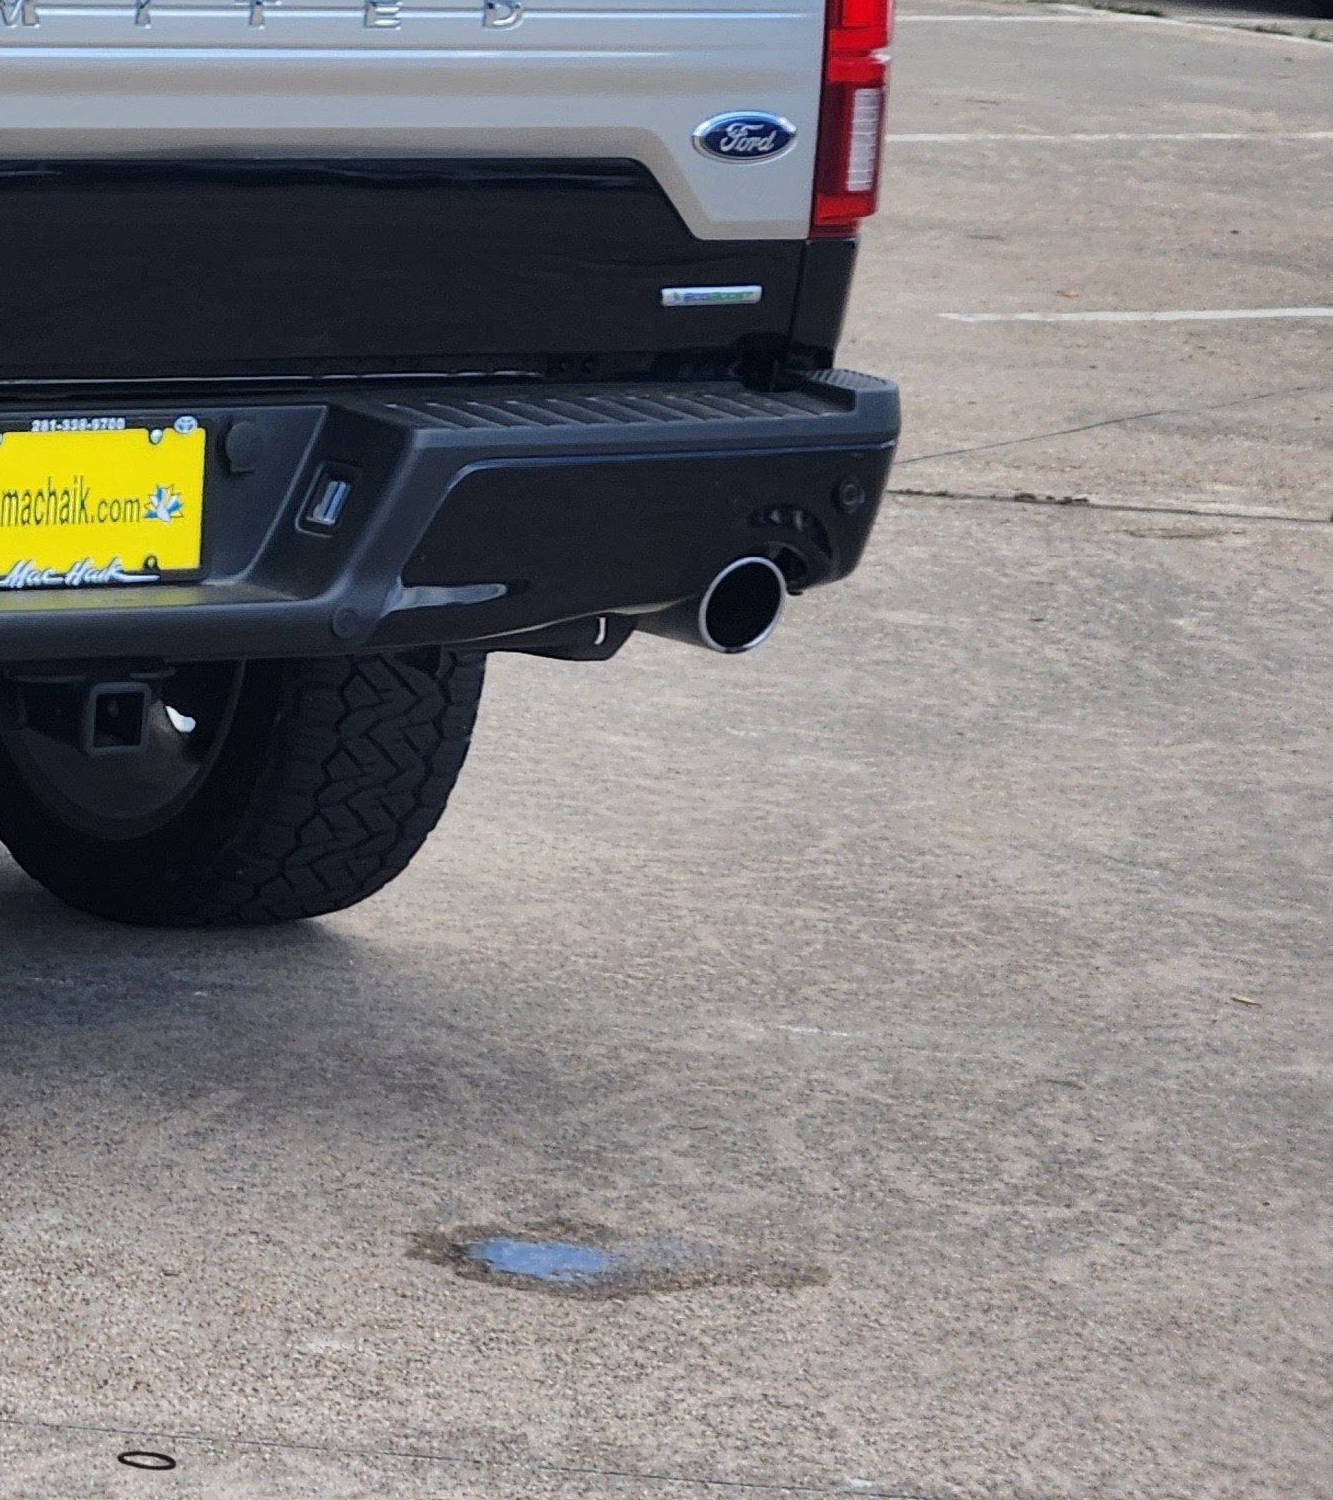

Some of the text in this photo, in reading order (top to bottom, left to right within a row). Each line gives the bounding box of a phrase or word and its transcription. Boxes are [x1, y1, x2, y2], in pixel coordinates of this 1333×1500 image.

[719, 121, 777, 152] Ford
[0, 474, 141, 527] machaik.com
[6, 558, 64, 589] Mac
